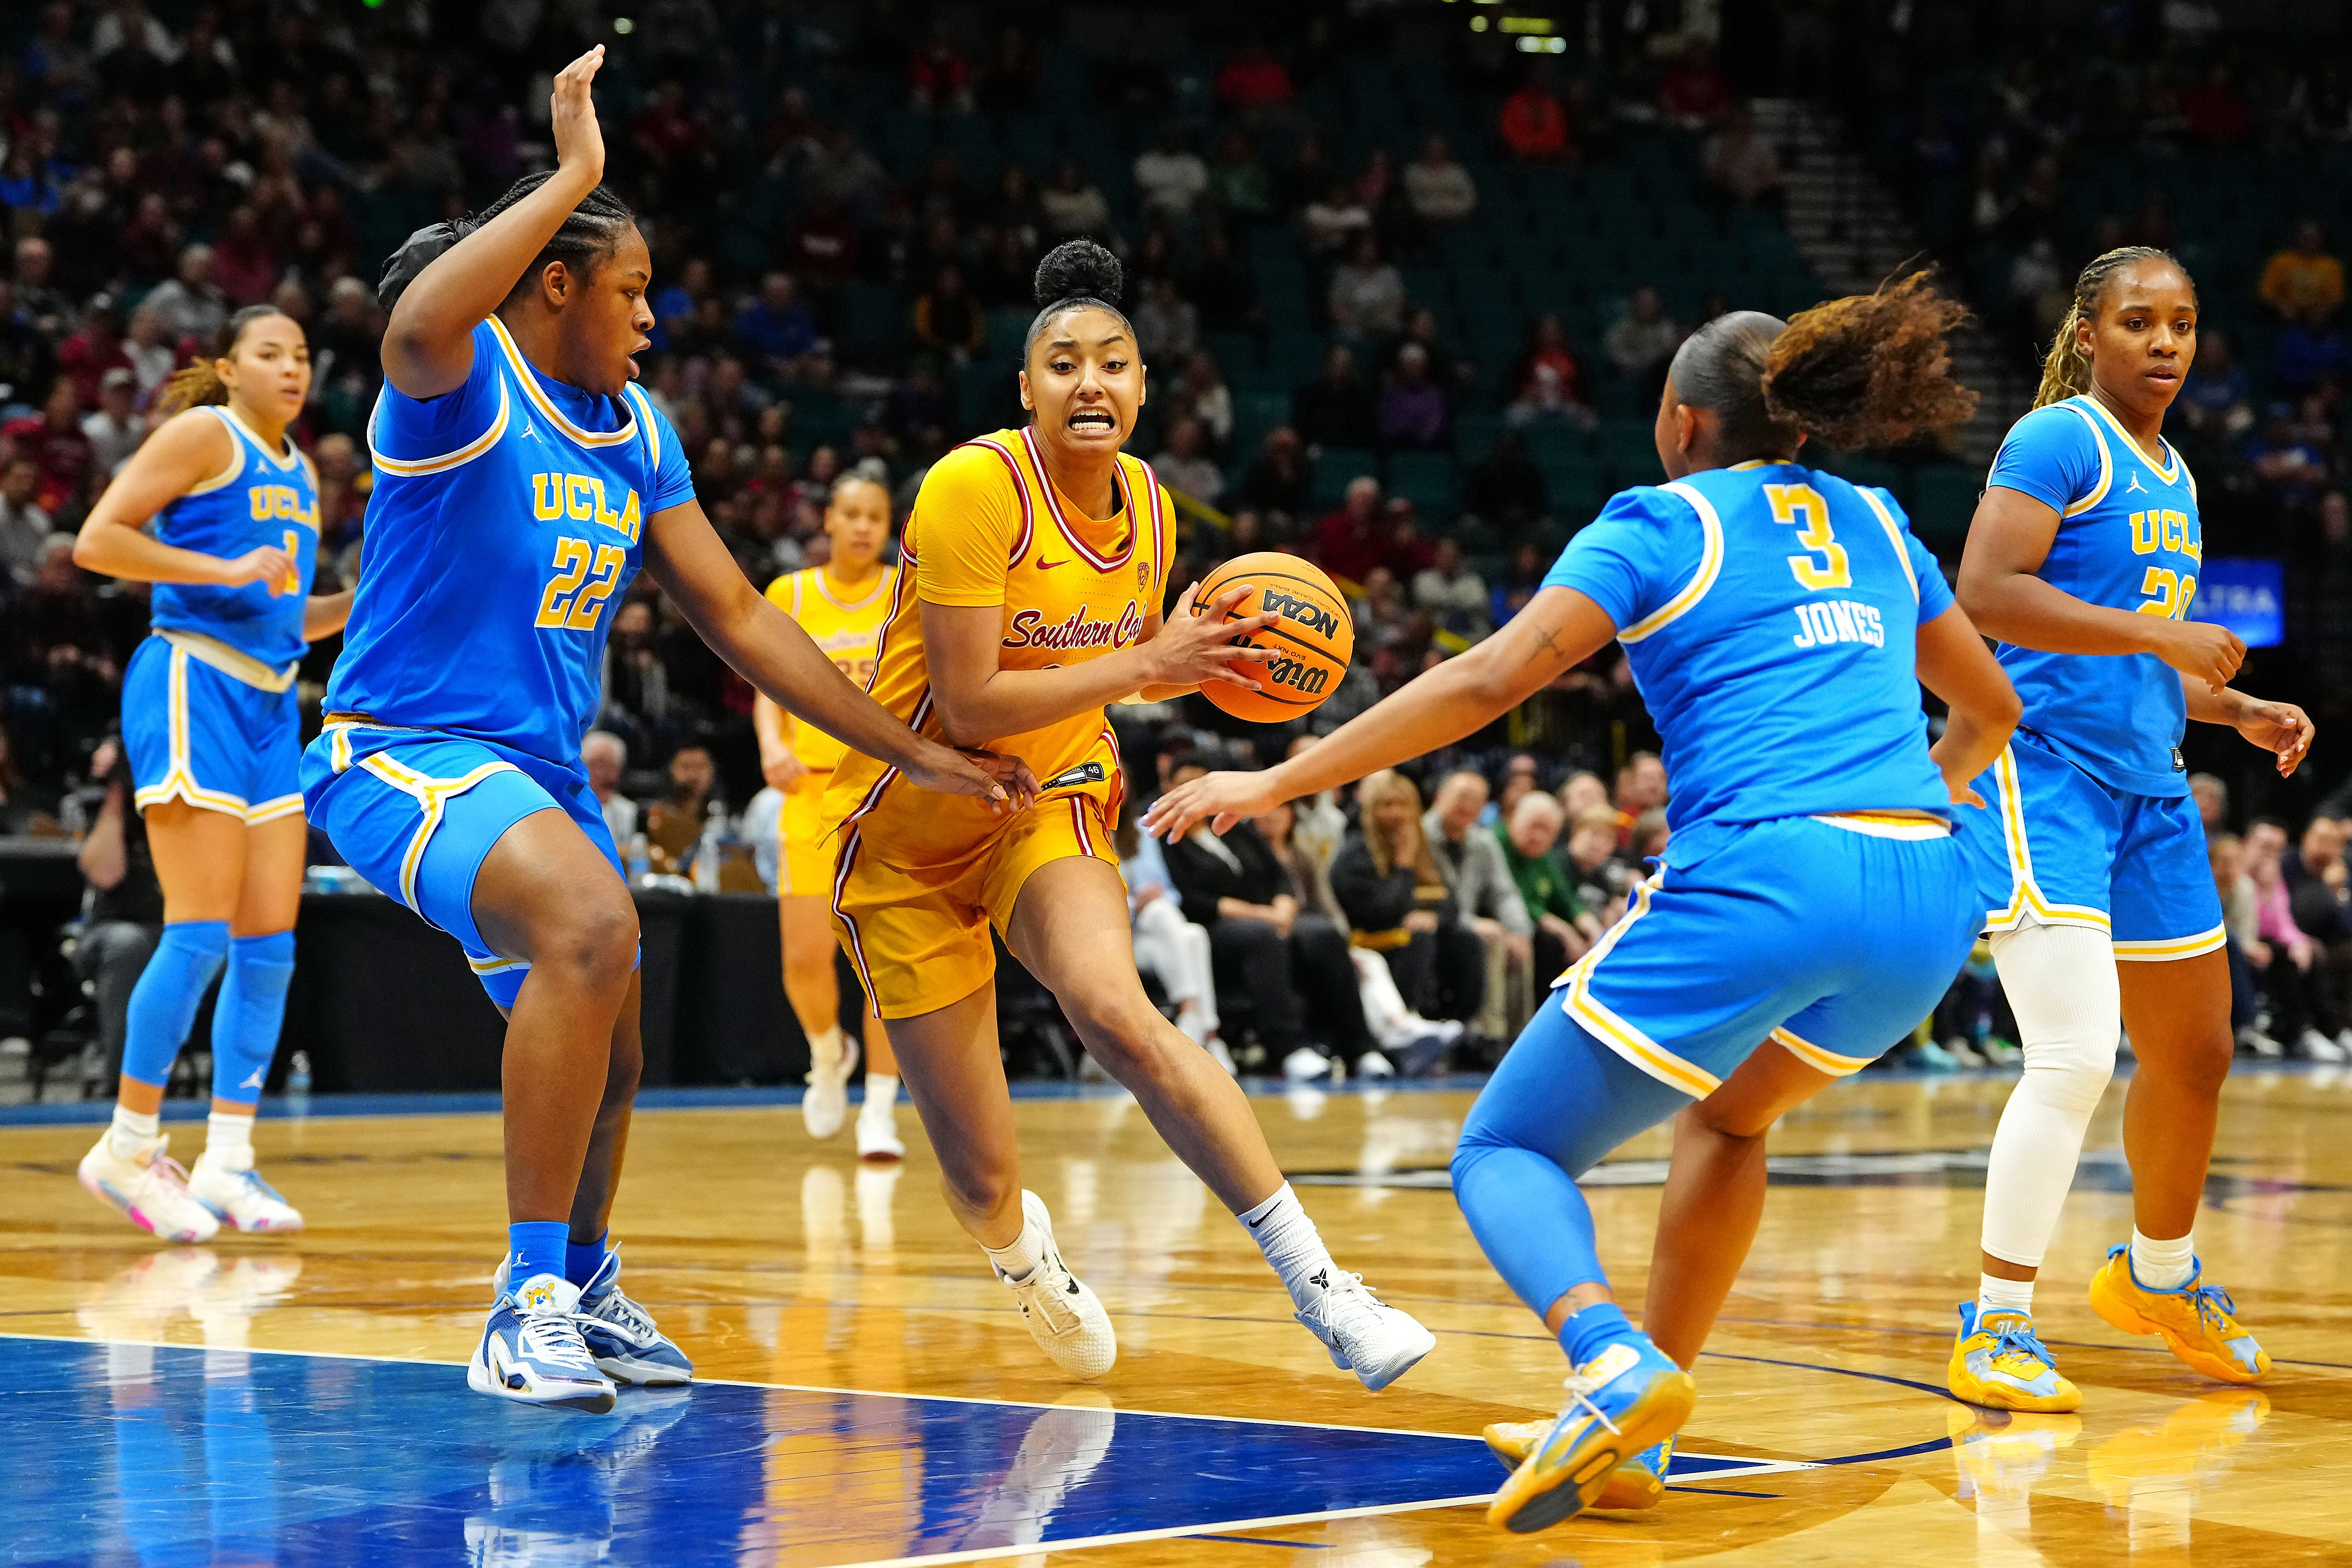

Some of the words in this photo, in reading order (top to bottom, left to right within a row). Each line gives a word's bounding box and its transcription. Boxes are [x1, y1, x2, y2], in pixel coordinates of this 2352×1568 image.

[532, 472, 641, 545] UCLA
[1762, 482, 1853, 592] 3
[2129, 508, 2202, 568] UCL
[534, 536, 626, 631] 22
[1268, 583, 1290, 593] BALL
[1291, 589, 1314, 602] GAME
[2136, 566, 2196, 622] 20
[2196, 583, 2277, 615] LTRA
[1002, 603, 1115, 651] Southern
[1262, 589, 1339, 640] NCAA
[1315, 599, 1341, 619] OFFICIAL
[1793, 600, 1885, 649] JONES
[1272, 644, 1290, 654] NXT
[1290, 651, 1307, 661] EVO
[1088, 766, 1100, 774] 46
